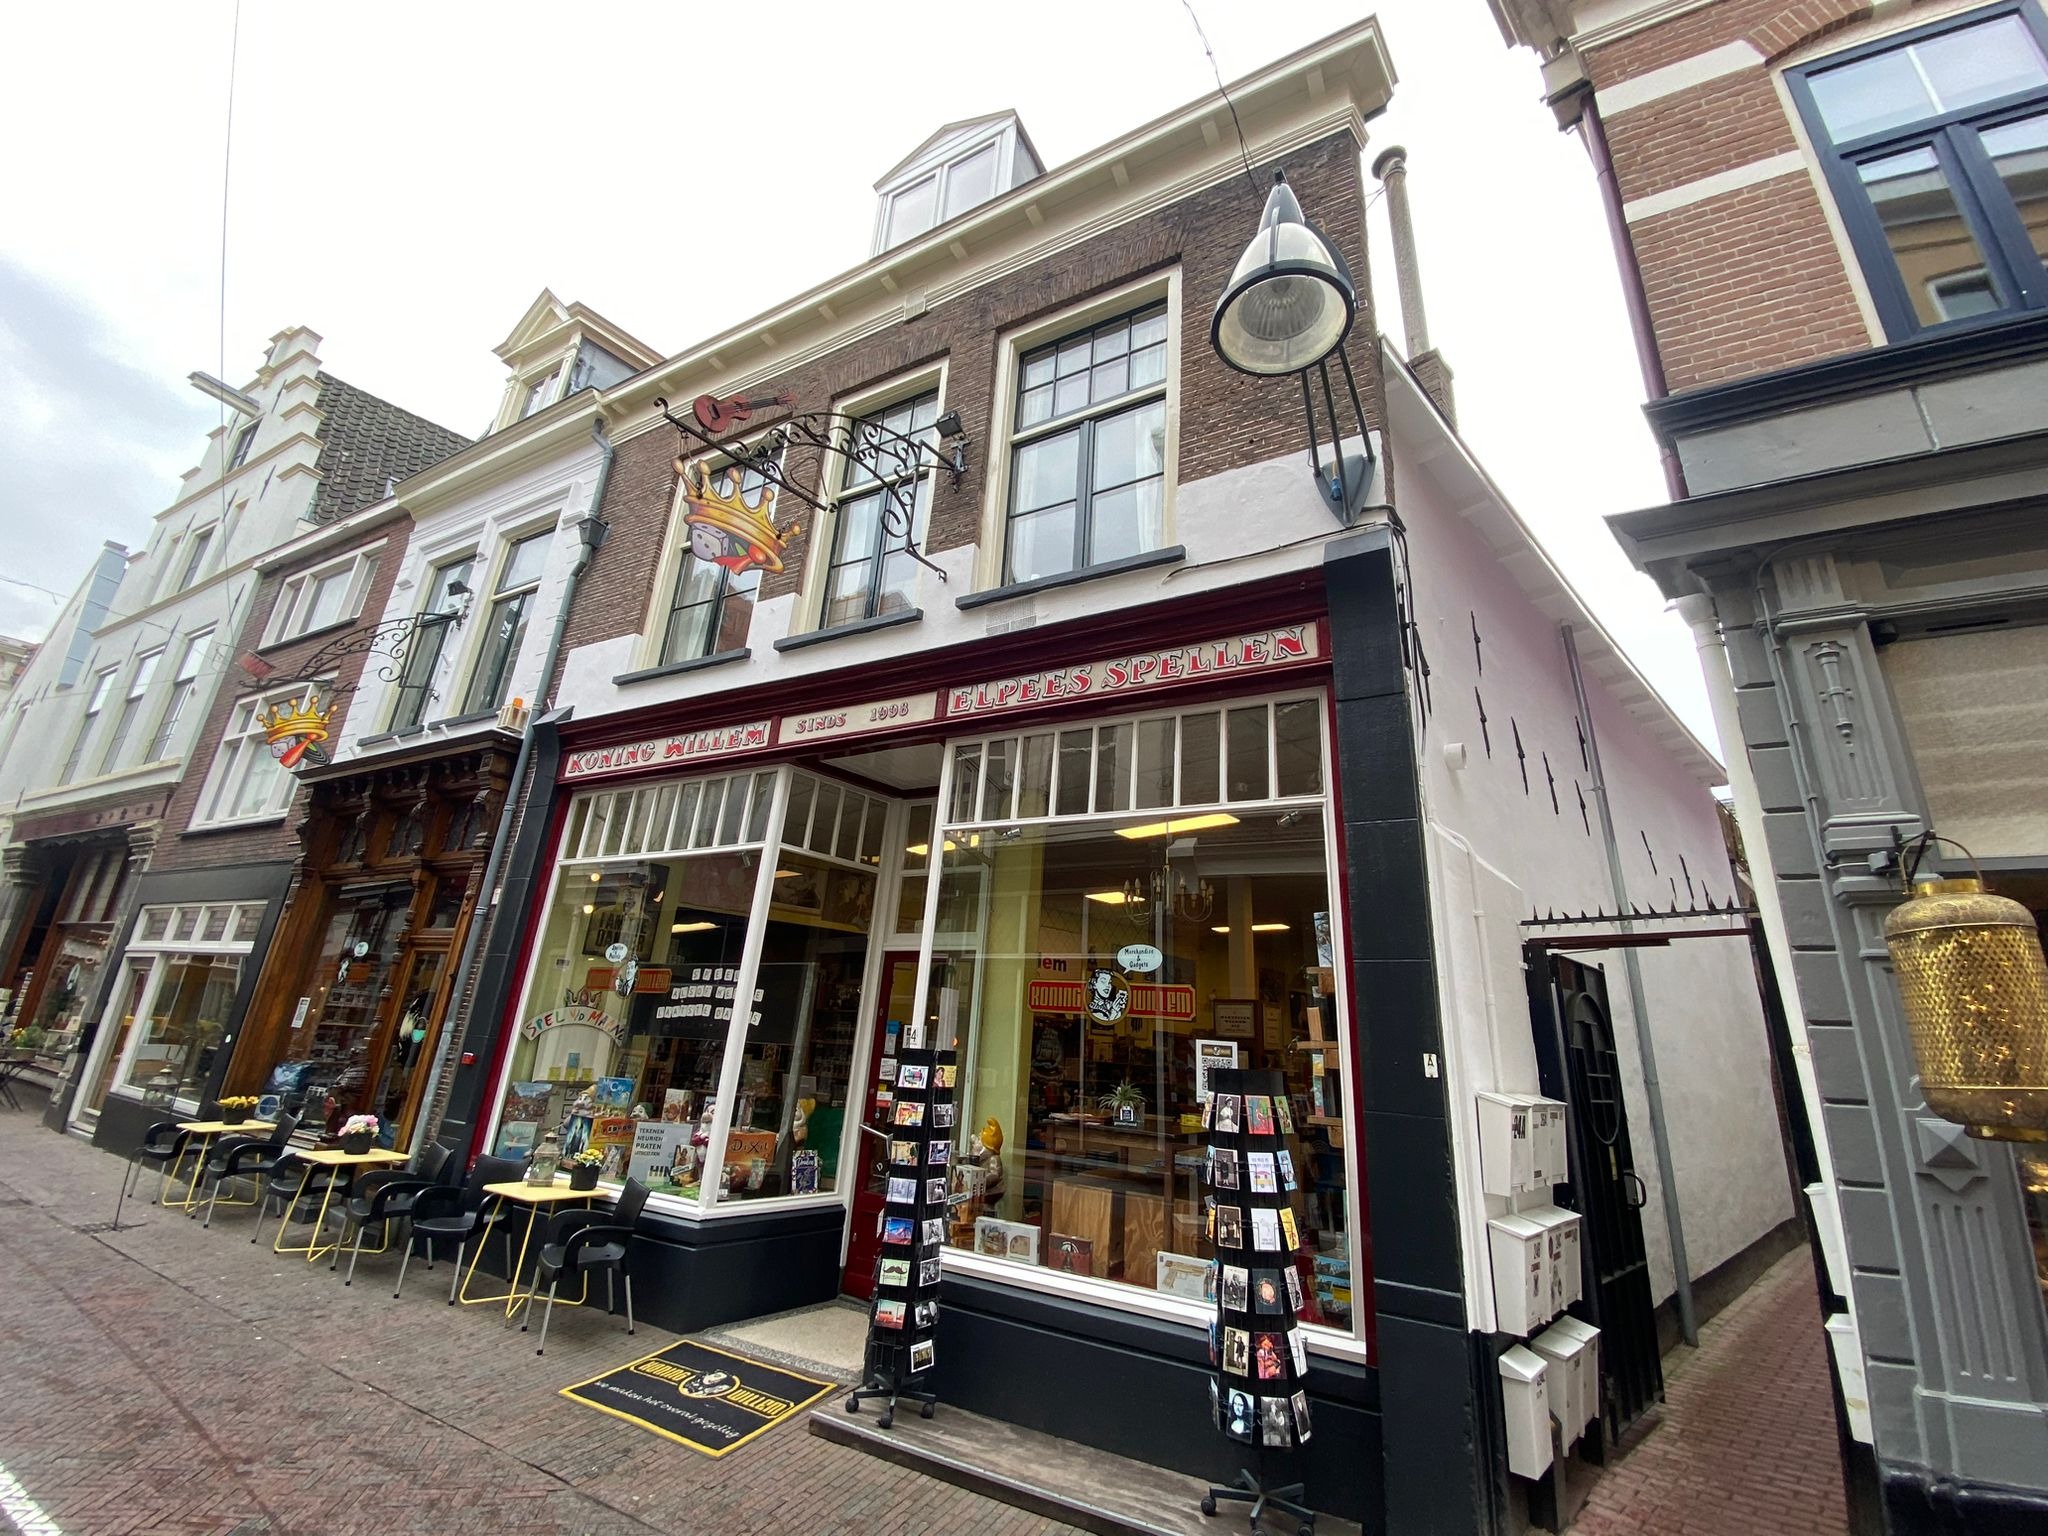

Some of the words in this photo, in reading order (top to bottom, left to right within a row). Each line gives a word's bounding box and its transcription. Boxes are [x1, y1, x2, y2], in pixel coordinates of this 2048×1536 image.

[950, 665, 1092, 714] ELPEES
[1101, 625, 1308, 690] SPELLEN
[795, 712, 847, 734] SINDS
[869, 702, 910, 722] 1998
[567, 741, 656, 774] KONING
[663, 720, 768, 759] WILLEM
[1031, 985, 1083, 1008] KONING
[1132, 989, 1192, 1014] WILLEM
[526, 1011, 566, 1038] SPEL
[638, 1360, 691, 1382] KONING
[727, 1388, 789, 1416] WILLEM
